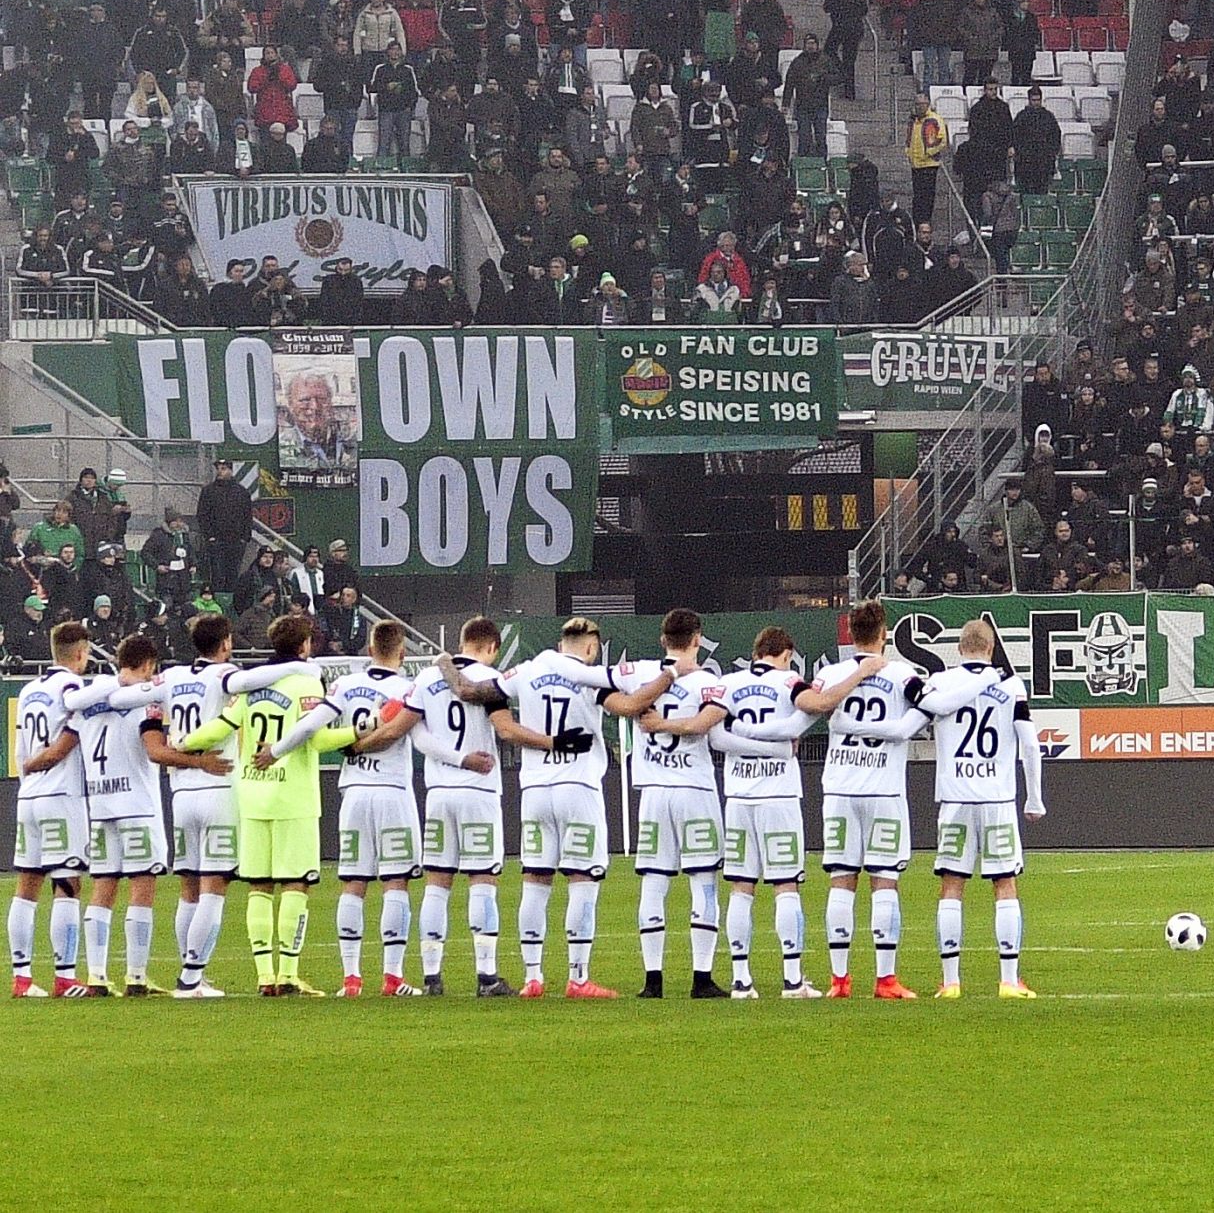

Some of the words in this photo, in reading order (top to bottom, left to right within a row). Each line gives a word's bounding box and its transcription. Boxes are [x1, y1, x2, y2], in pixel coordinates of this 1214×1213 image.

[212, 186, 327, 240] VIRIBUS
[335, 186, 428, 242] UNITIS
[282, 333, 345, 342] Christian
[680, 336, 735, 355] FAN
[748, 336, 819, 356] CLUB
[621, 343, 668, 358] OLD
[137, 337, 277, 444] FLO
[679, 367, 811, 393] SPEISING
[914, 384, 938, 394] RAPID
[941, 385, 963, 395] WIEN
[620, 403, 677, 421] STYLE
[680, 400, 760, 422] SINCE
[769, 402, 822, 422] 1981
[359, 455, 575, 567] BOYS
[448, 701, 466, 751] 9
[542, 694, 571, 737] 17
[955, 706, 999, 759] 26
[1090, 733, 1152, 753] WIEN
[93, 725, 109, 775] 4
[955, 762, 996, 778] KOCH
